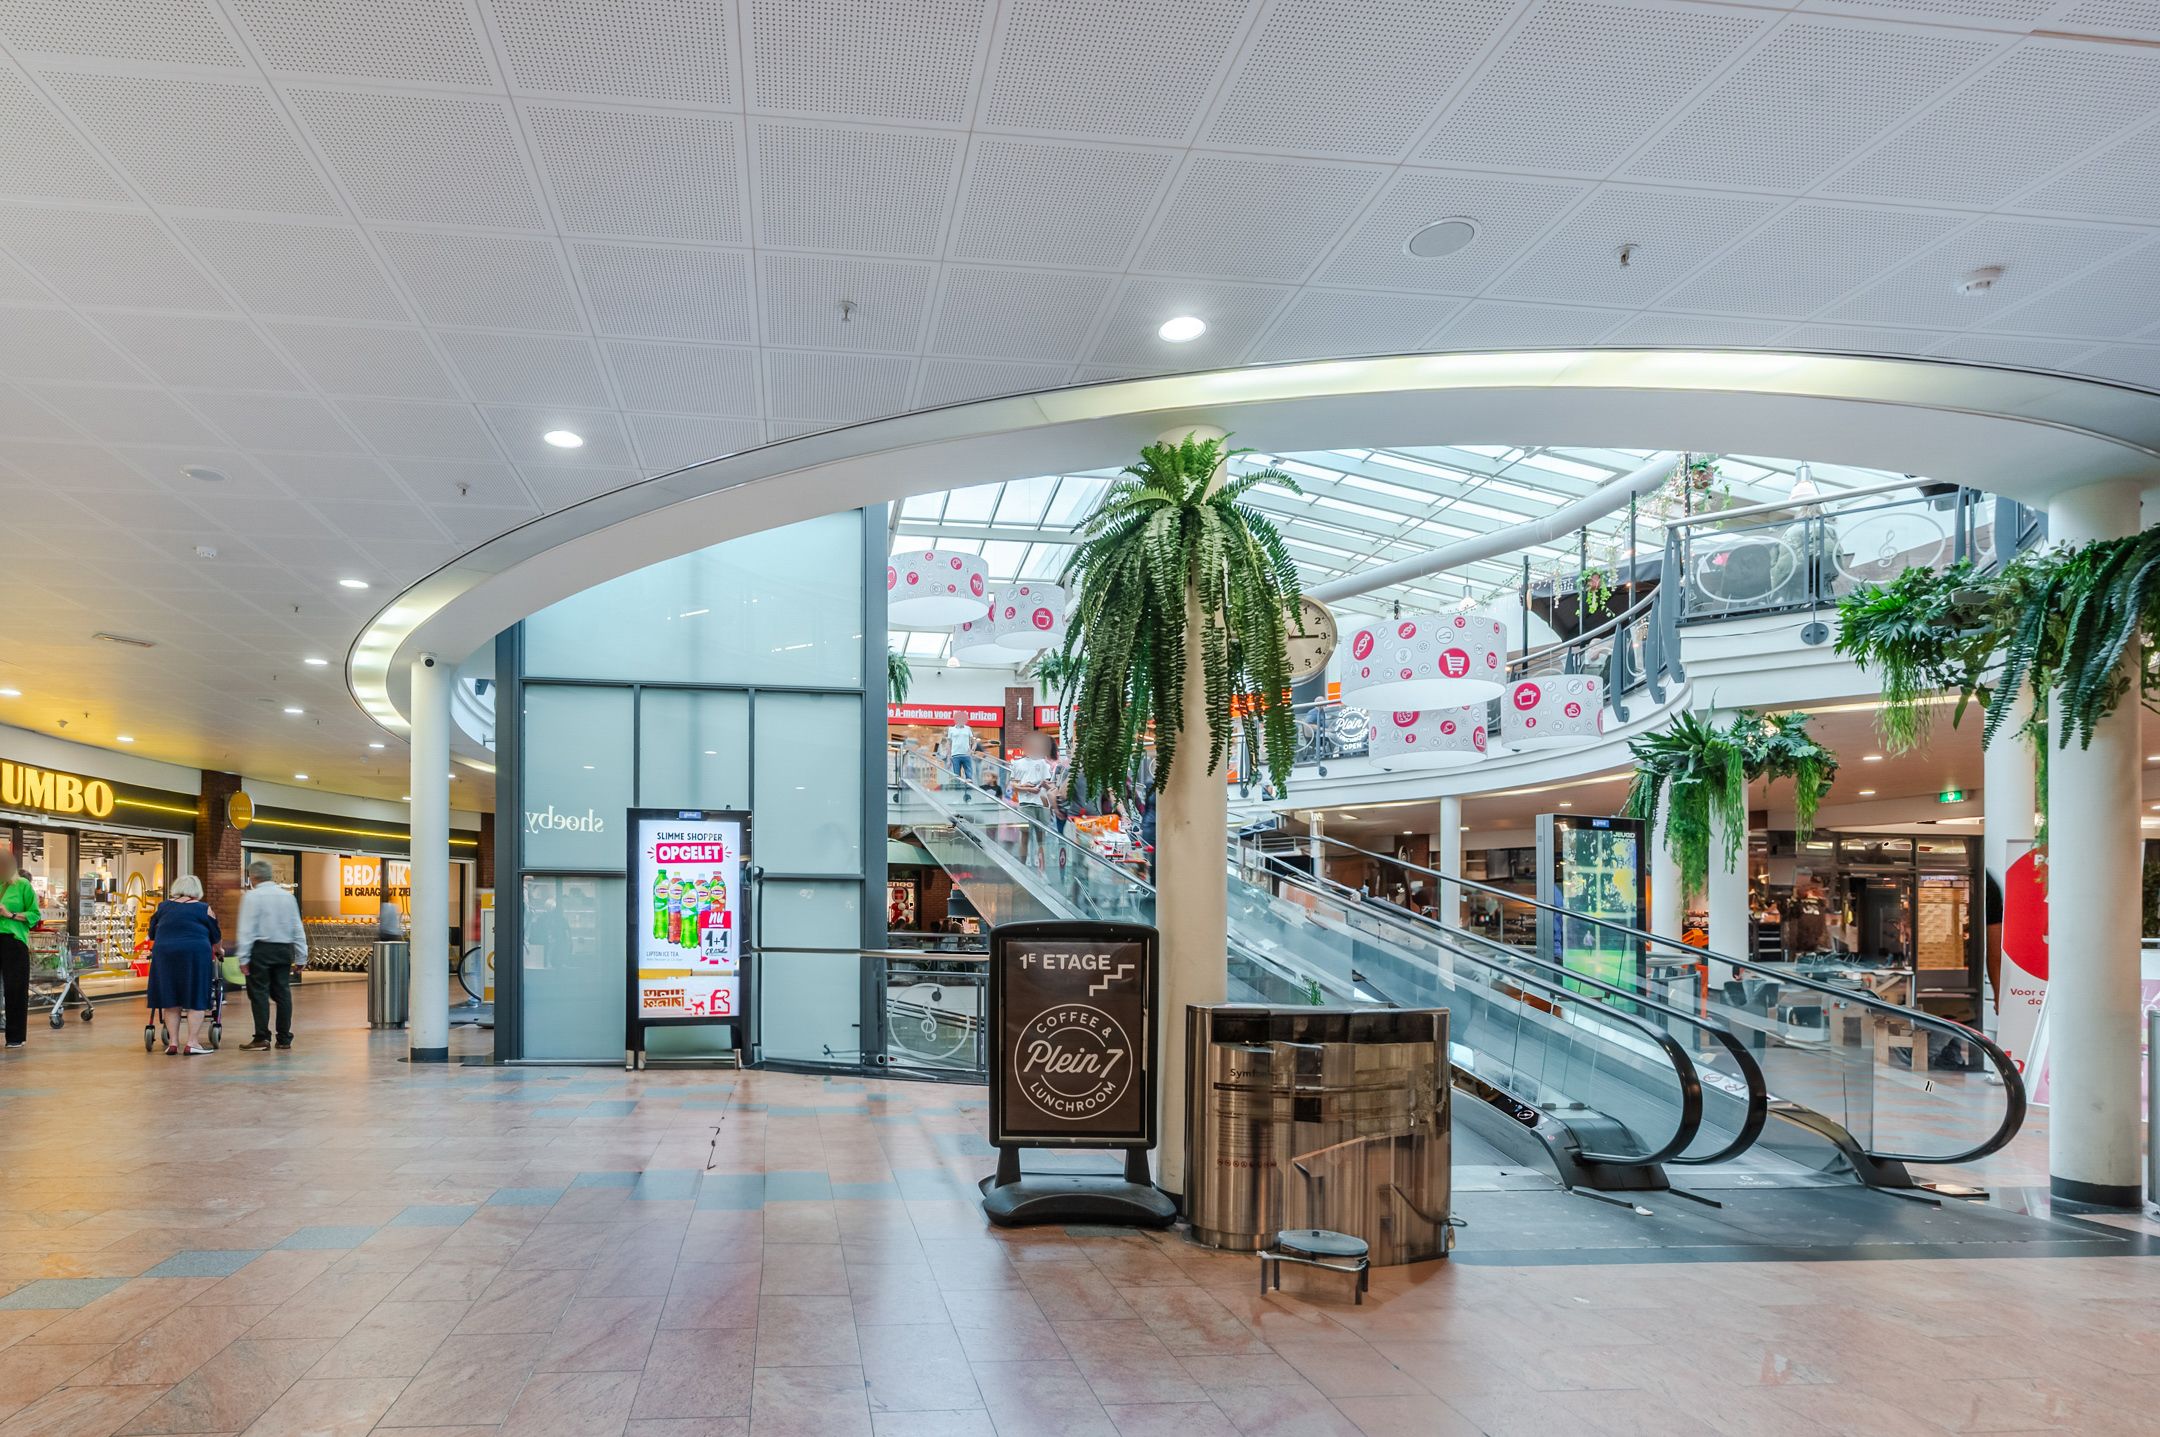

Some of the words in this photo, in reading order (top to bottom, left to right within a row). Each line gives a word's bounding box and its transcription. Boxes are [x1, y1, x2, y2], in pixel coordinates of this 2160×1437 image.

[1314, 616, 1322, 625] 2
[1320, 632, 1328, 640] 3
[1314, 647, 1323, 655] 4
[1304, 658, 1312, 667] 5
[895, 708, 933, 719] A-merken
[934, 709, 952, 720] voor
[969, 711, 997, 722] prijzen
[1342, 742, 1362, 750] OPEN
[657, 832, 685, 841] SLIMME
[687, 832, 723, 841] SHOPPER
[659, 845, 720, 861] OPGELET
[343, 864, 411, 886] BEDANK
[344, 887, 353, 896] EN
[708, 912, 725, 924] nu
[704, 930, 729, 948] 1+1
[1019, 953, 1037, 970] 1E
[1042, 953, 1112, 971] ETAGE
[2010, 988, 2036, 997] Voor
[1036, 1011, 1100, 1034] COFFEE
[1101, 1026, 1113, 1039] &
[1023, 1039, 1102, 1074] Plein
[1099, 1048, 1125, 1079] 7
[1029, 1081, 1118, 1113] LUNCHROOM
